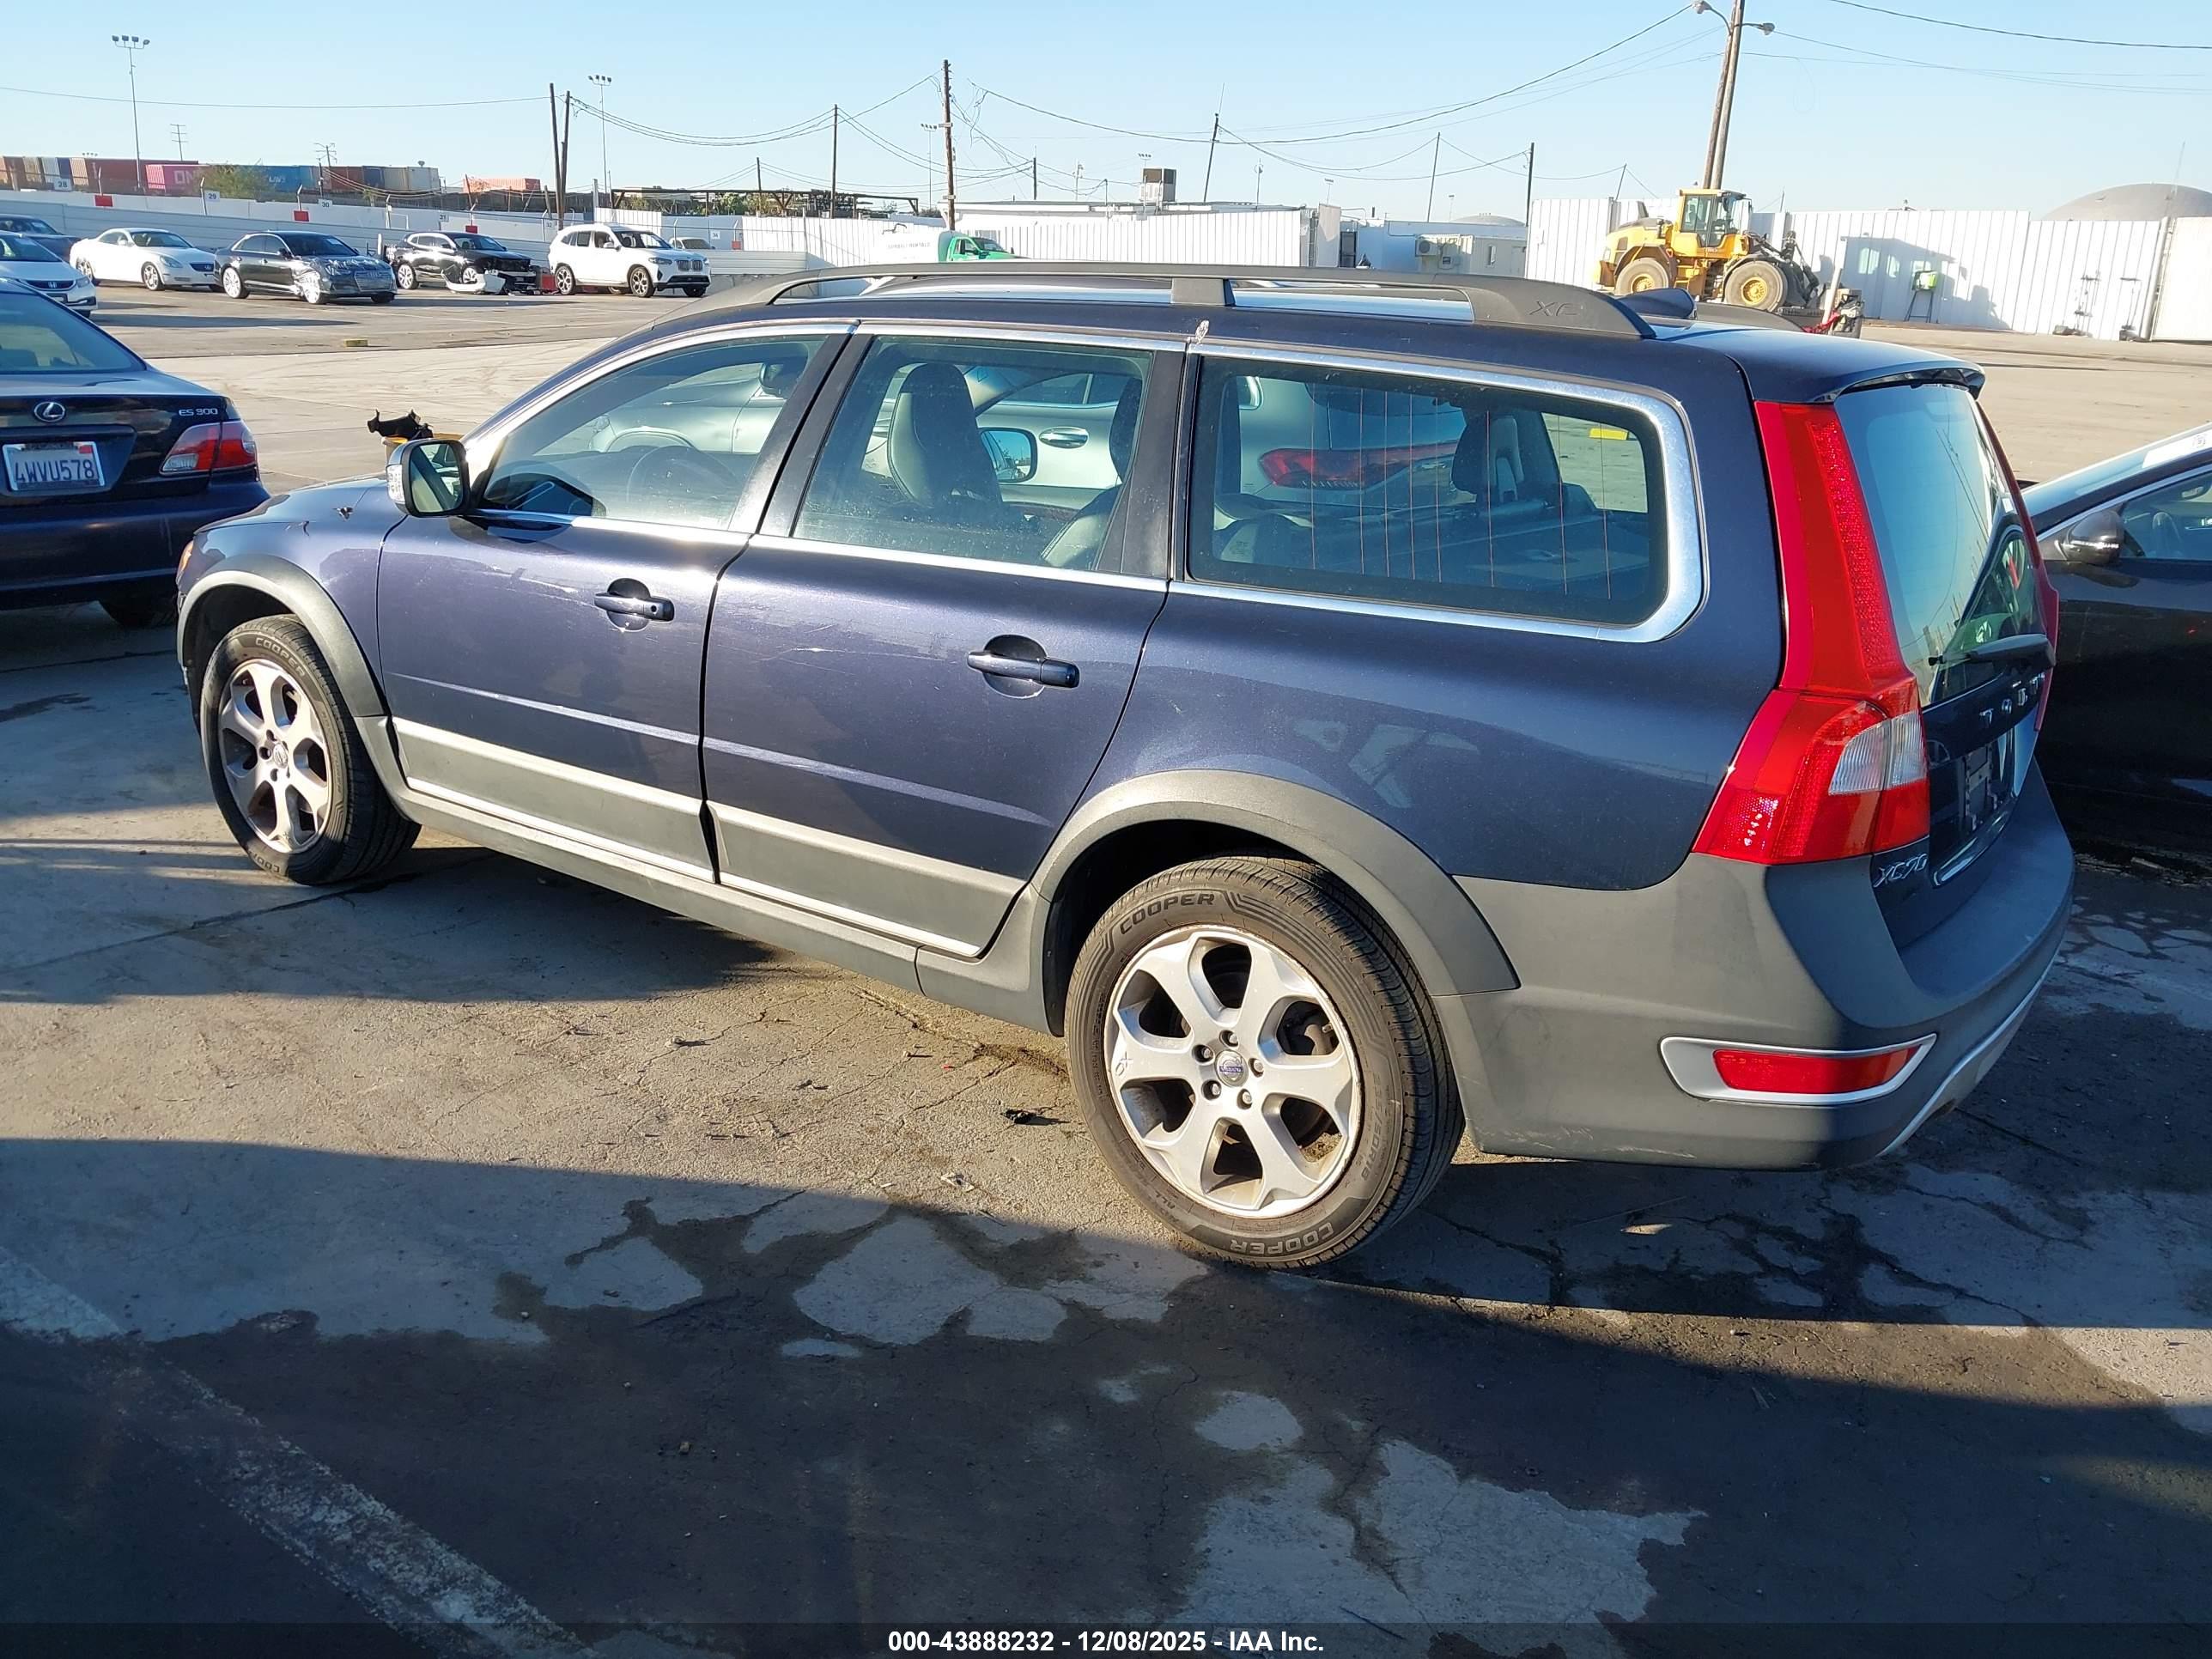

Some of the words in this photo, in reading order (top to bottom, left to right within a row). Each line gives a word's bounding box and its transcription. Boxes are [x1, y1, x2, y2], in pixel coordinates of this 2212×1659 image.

[15, 459, 95, 483] 4WVU578
[255, 637, 306, 677] COOPER
[1873, 853, 1928, 888] XC70
[1120, 893, 1215, 935] COOPER
[1230, 1222, 1334, 1255] COOPER
